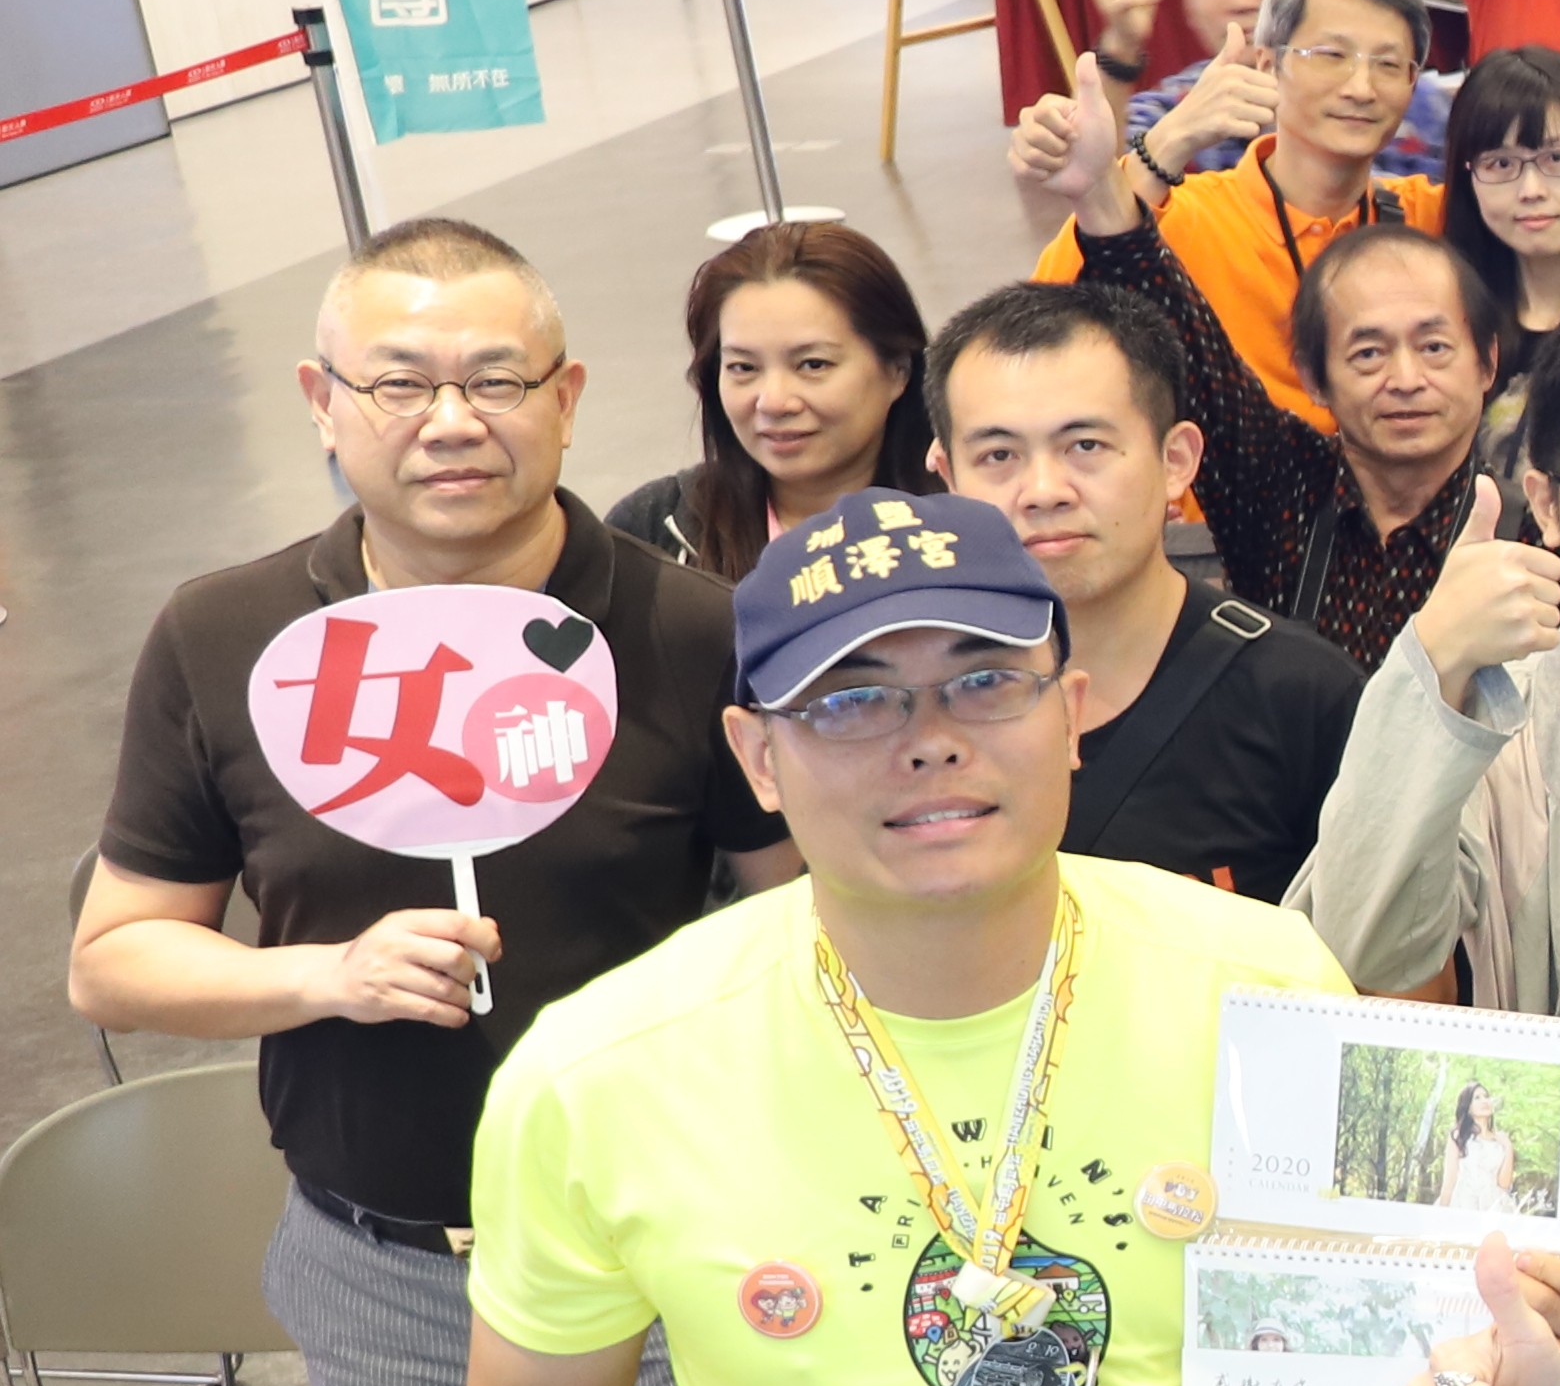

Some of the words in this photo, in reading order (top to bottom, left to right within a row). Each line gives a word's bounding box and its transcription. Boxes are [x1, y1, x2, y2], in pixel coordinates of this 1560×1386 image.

[790, 529, 959, 607] 順澤宮
[273, 616, 590, 816] 女神
[1252, 1154, 1310, 1177] 2020
